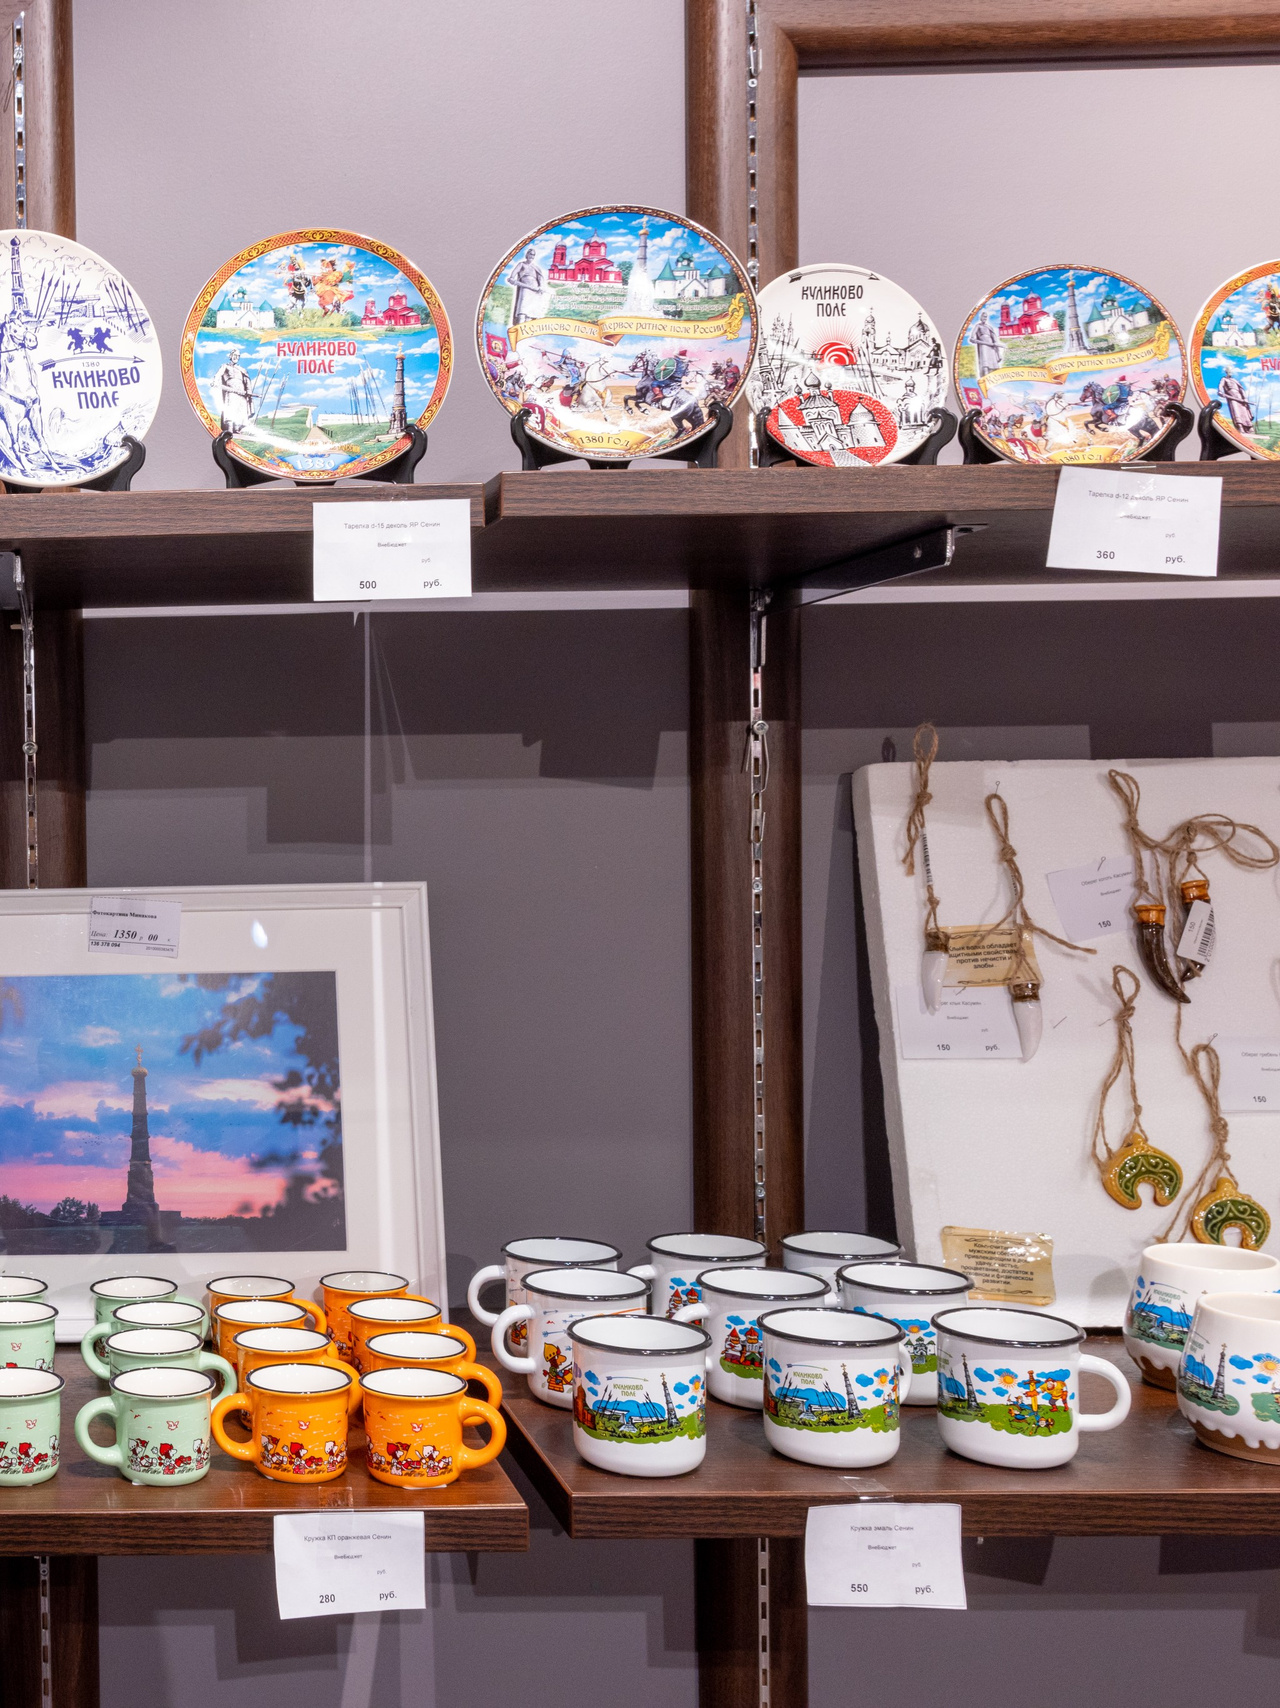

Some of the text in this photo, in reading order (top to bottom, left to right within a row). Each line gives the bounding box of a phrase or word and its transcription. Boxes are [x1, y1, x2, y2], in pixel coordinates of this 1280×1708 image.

[801, 284, 864, 300] КУЛИКОВО
[816, 302, 846, 317] ПОЛЕ
[519, 322, 571, 337] Куликово
[574, 324, 598, 336] поле
[670, 323, 691, 334] поле
[692, 322, 725, 334] России
[276, 341, 357, 357] КУЛИКОВО
[297, 359, 335, 374] ПОЛЕ
[52, 366, 140, 388] КУЛИКОВО
[77, 391, 119, 410] ПОЛЕ
[579, 435, 604, 444] 1380
[296, 458, 335, 469] 1380
[1096, 550, 1186, 564] 360 руб.
[359, 579, 442, 589] 500 руб.
[1098, 920, 1112, 929] 150
[1188, 921, 1196, 933] 150
[114, 929, 137, 940] 1350
[148, 933, 158, 941] 00
[1253, 1095, 1267, 1103] 150
[793, 1371, 823, 1380] КУЛИКОВО
[613, 1383, 644, 1391] КУЛИКОВО
[304, 1535, 326, 1543] Кружка
[850, 1583, 934, 1595] 550 руб.
[319, 1591, 397, 1604] 280 руб.
